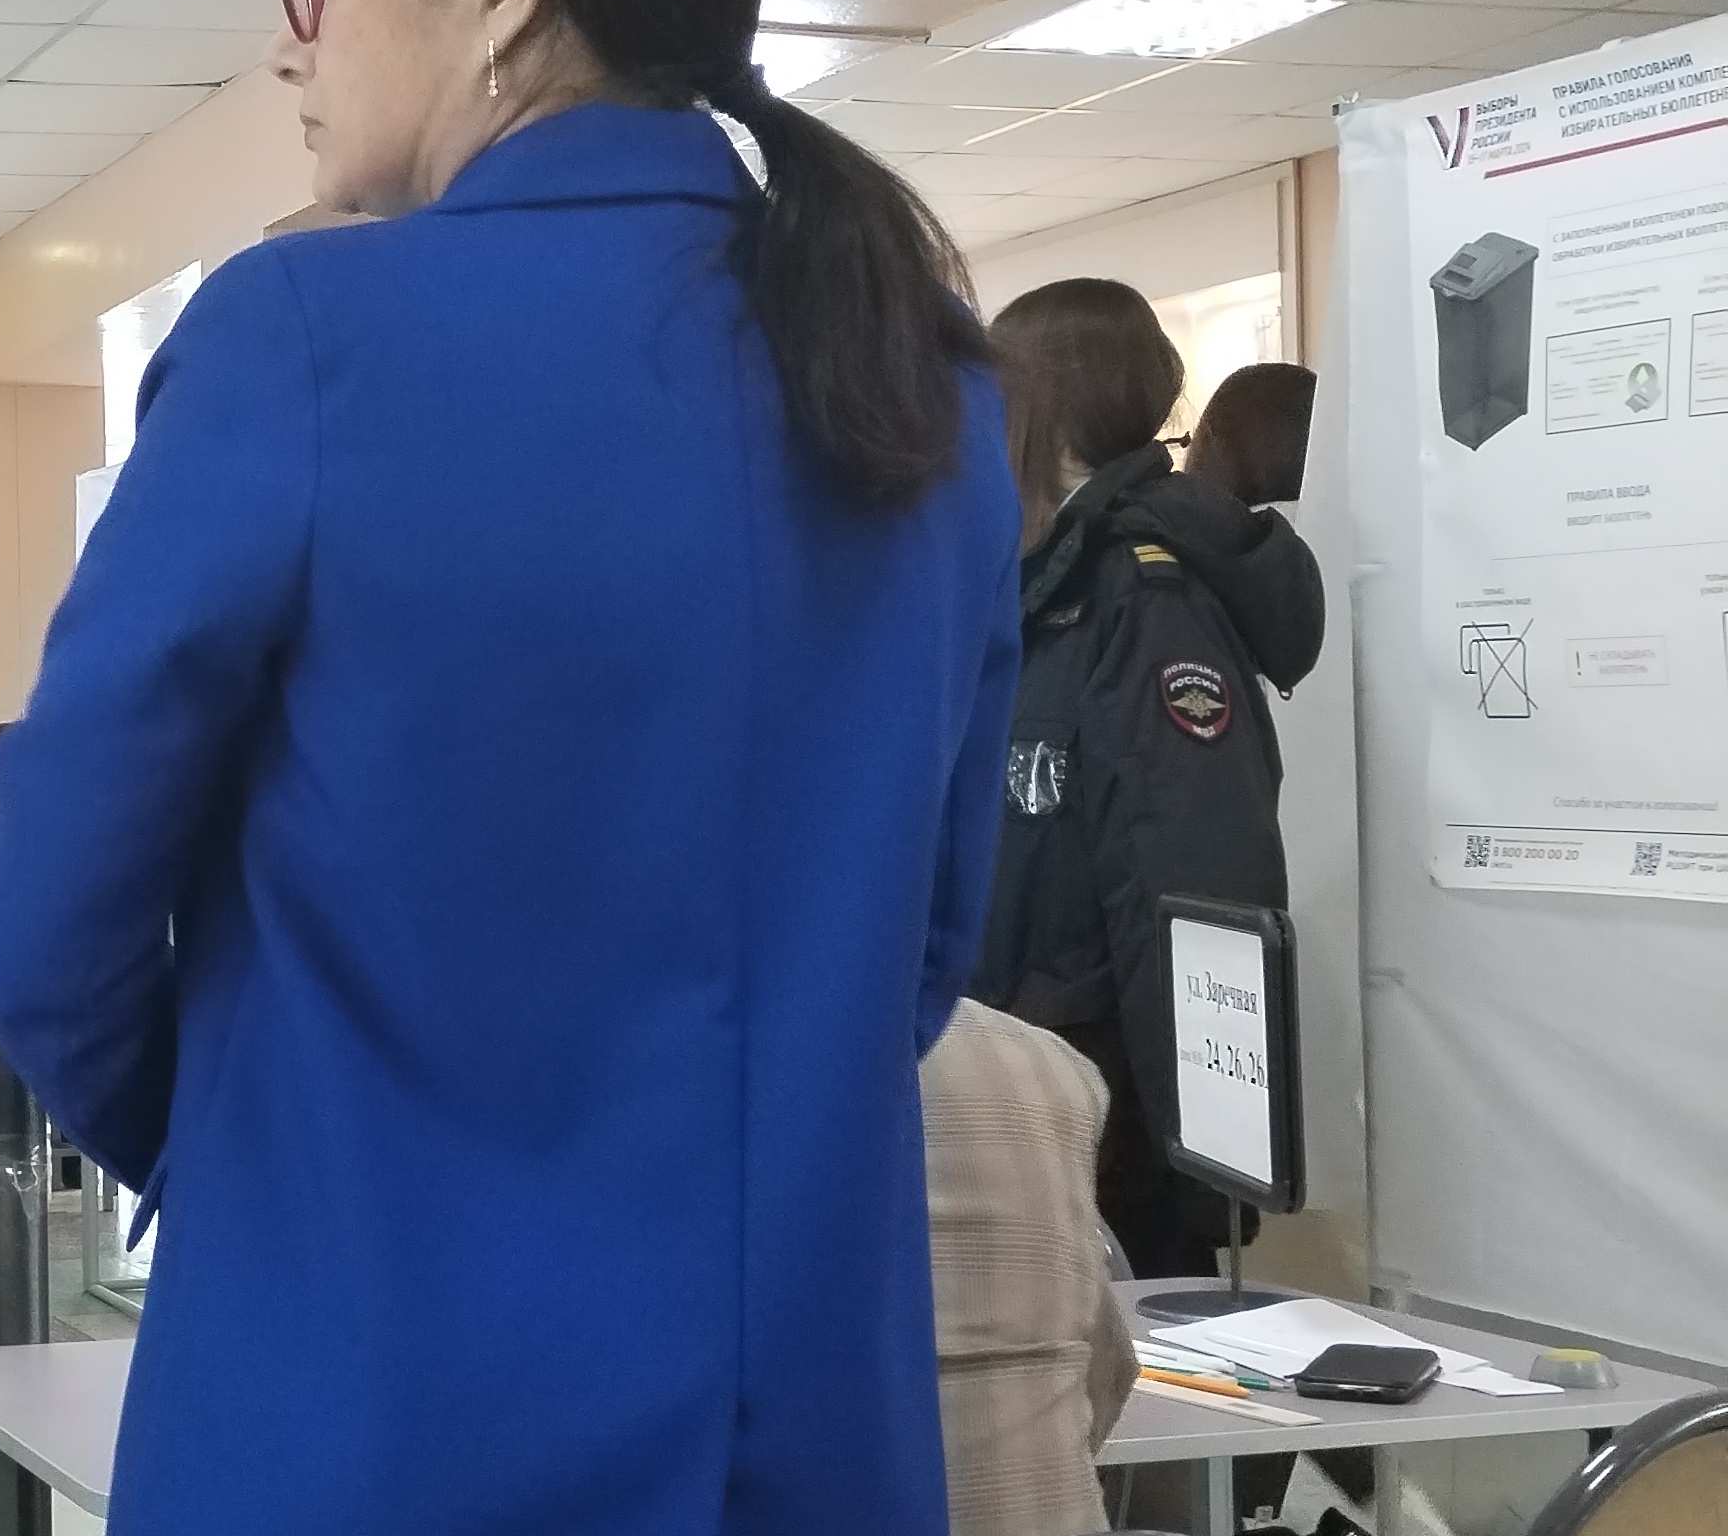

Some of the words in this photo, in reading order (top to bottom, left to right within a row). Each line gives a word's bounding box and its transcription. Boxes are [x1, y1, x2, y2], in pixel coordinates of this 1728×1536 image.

[1552, 76, 1607, 99] ПРАВИЛА
[1607, 53, 1693, 86] ГОЛОСОВАНИЯ
[1476, 94, 1519, 116] ВЫБОРЫ
[1569, 78, 1676, 116] ИСПОЛЬЗОВАНИЕМ
[1475, 106, 1537, 132] ПРЕЗИДЕНТА
[1561, 108, 1658, 139] ИЗБИРАТЕЛЬНЫХ
[1471, 130, 1512, 150] РОССИИ
[1163, 662, 1221, 683] ПОЛИЦИЯ
[1169, 675, 1221, 695] РОССИЯ
[1204, 970, 1258, 1015] Заречная
[1248, 1051, 1268, 1089] 26
